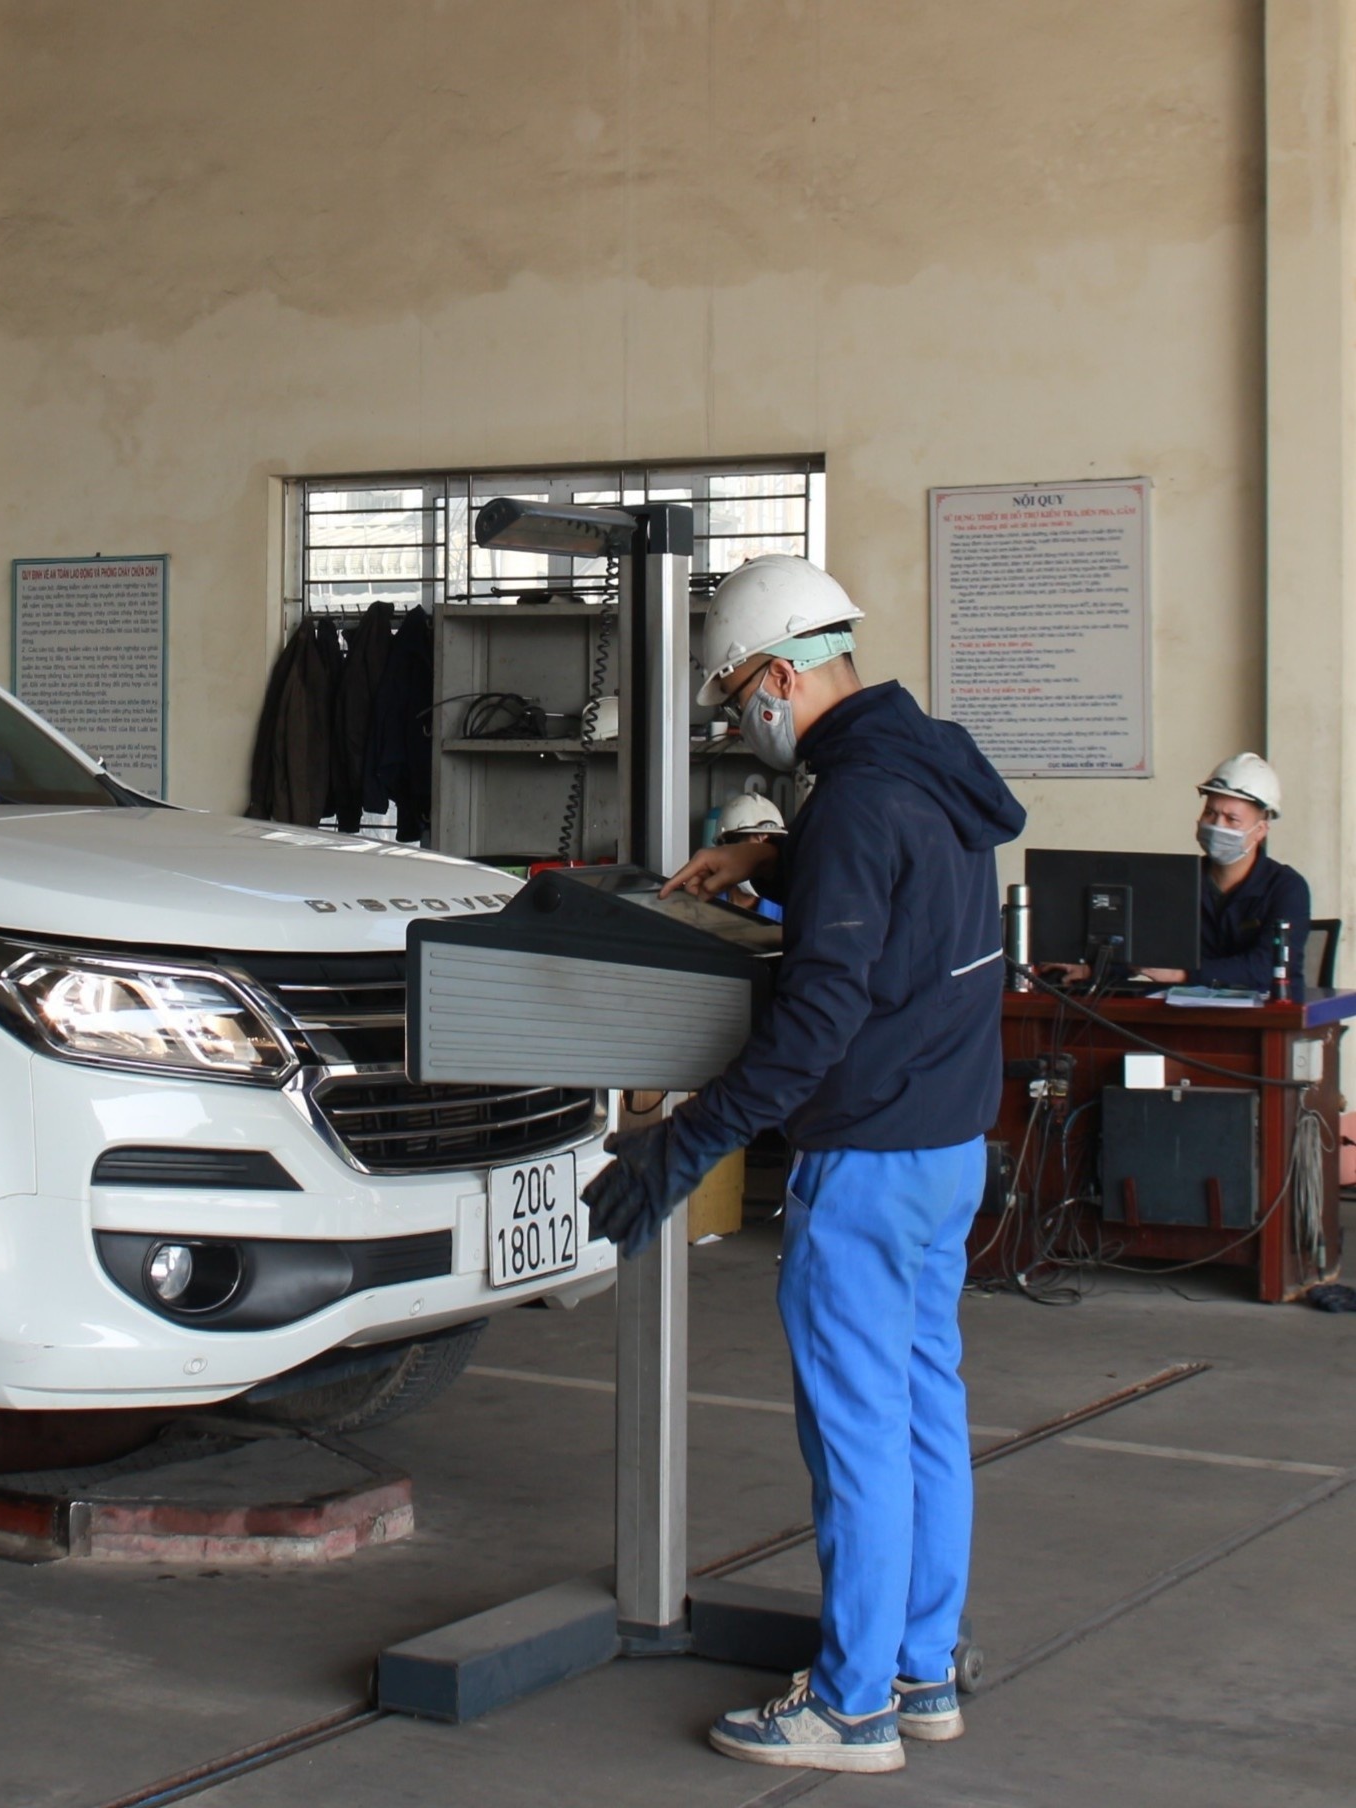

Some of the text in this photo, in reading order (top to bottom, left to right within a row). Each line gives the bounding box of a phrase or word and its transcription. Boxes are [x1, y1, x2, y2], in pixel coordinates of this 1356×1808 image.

[1012, 493, 1064, 508] NỘI QUY
[512, 1163, 556, 1219] 20C
[498, 1214, 573, 1278] 180.12
